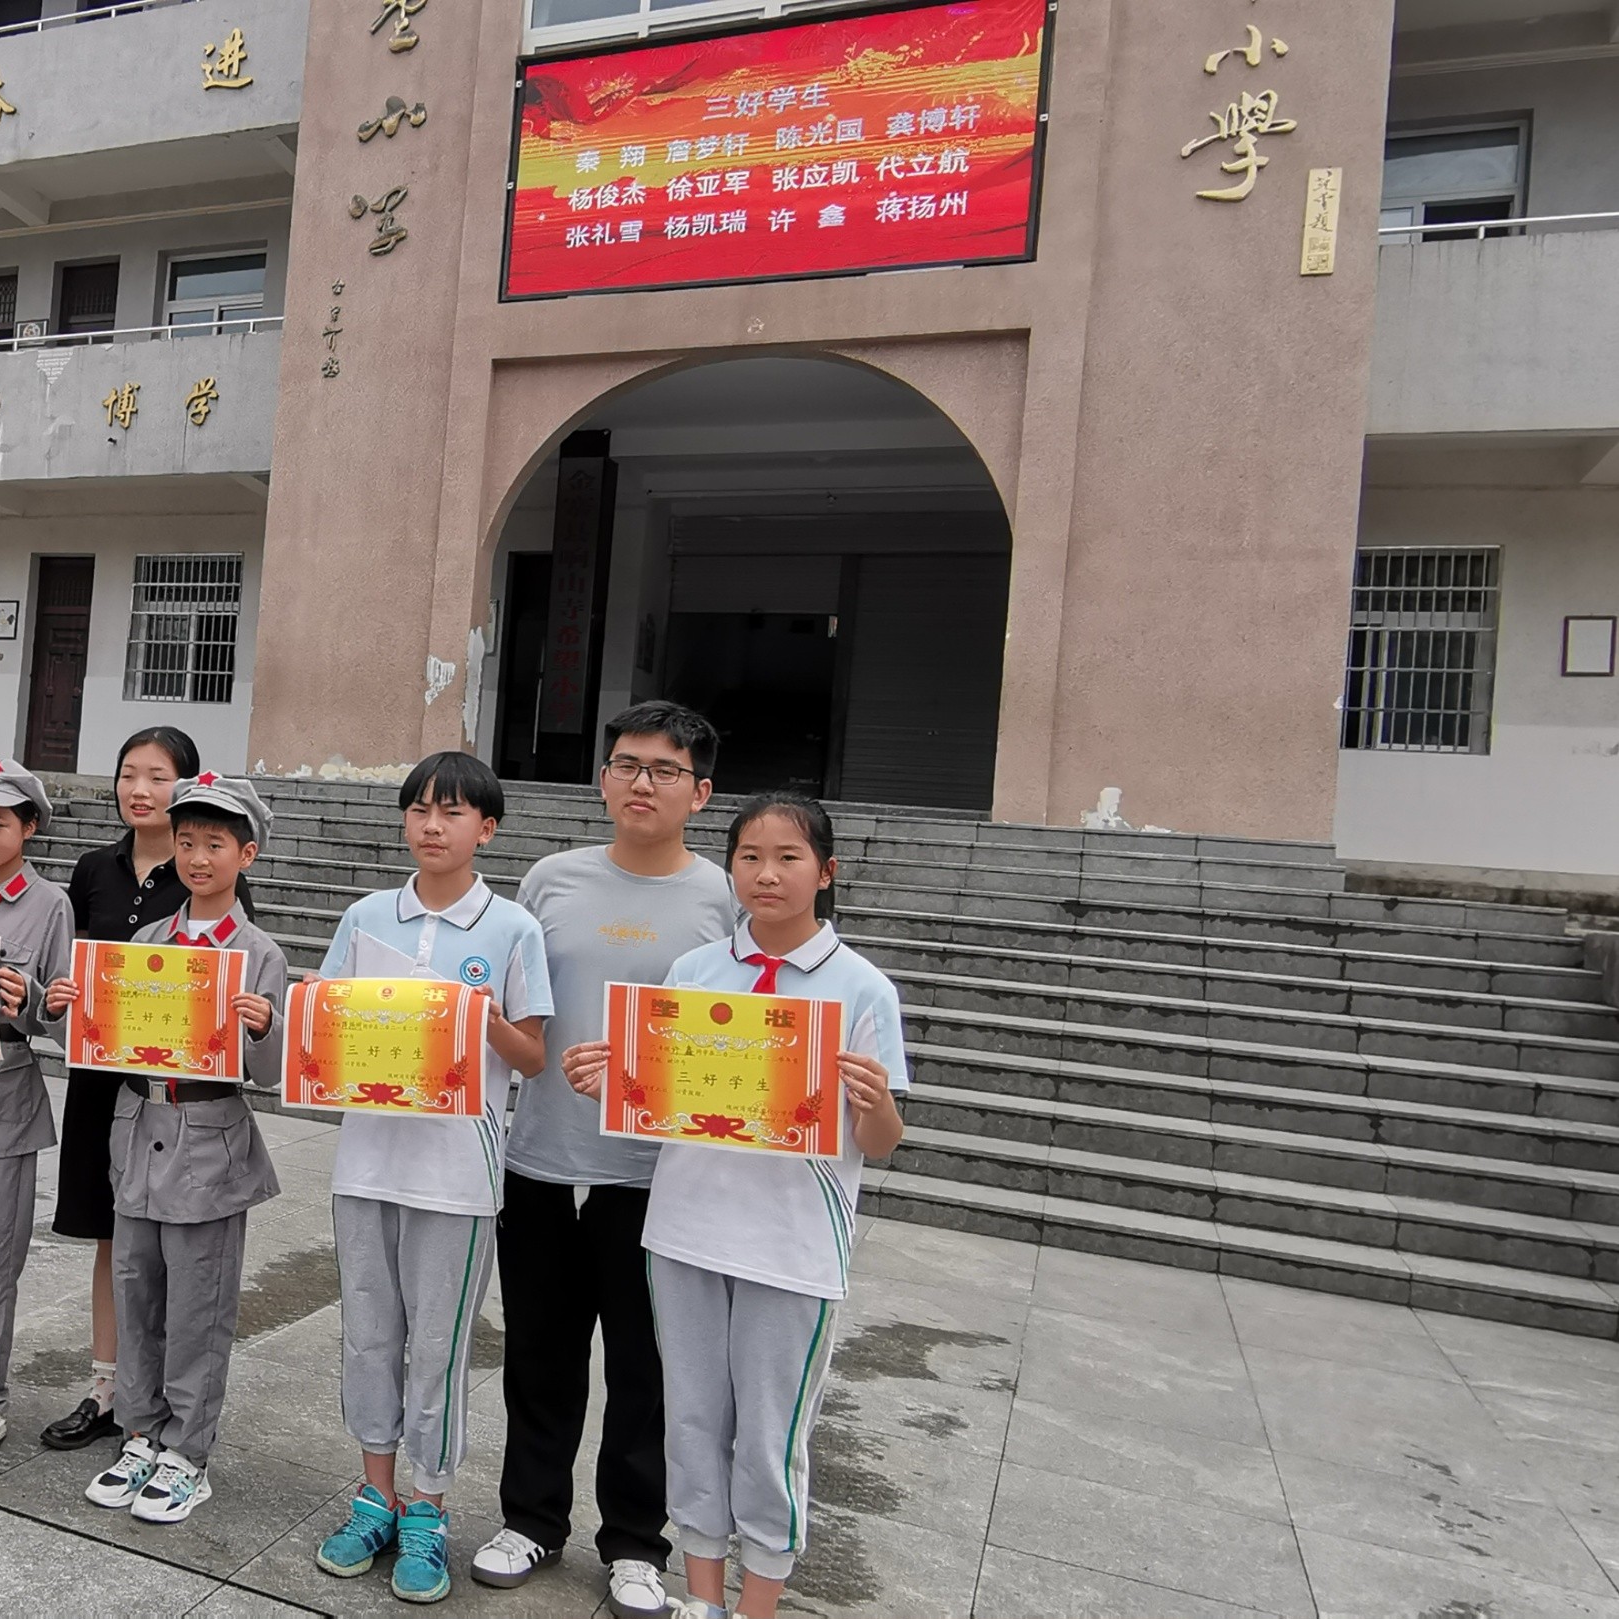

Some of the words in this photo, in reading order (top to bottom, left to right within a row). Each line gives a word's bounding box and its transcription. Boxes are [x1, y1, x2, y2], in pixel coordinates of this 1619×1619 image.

[702, 82, 830, 120] 三好学生
[775, 118, 865, 151] 陈光国
[568, 184, 647, 212] 杨俊杰
[666, 171, 750, 202] 徐亚军
[772, 161, 860, 192] 张应凯
[875, 149, 970, 182] 代立航
[565, 220, 644, 249] 张礼雪
[663, 209, 747, 240] 杨凯瑞
[875, 191, 969, 223] 蒋扬州
[346, 1045, 424, 1060] 三好学生
[676, 1071, 770, 1092] 三好学生
